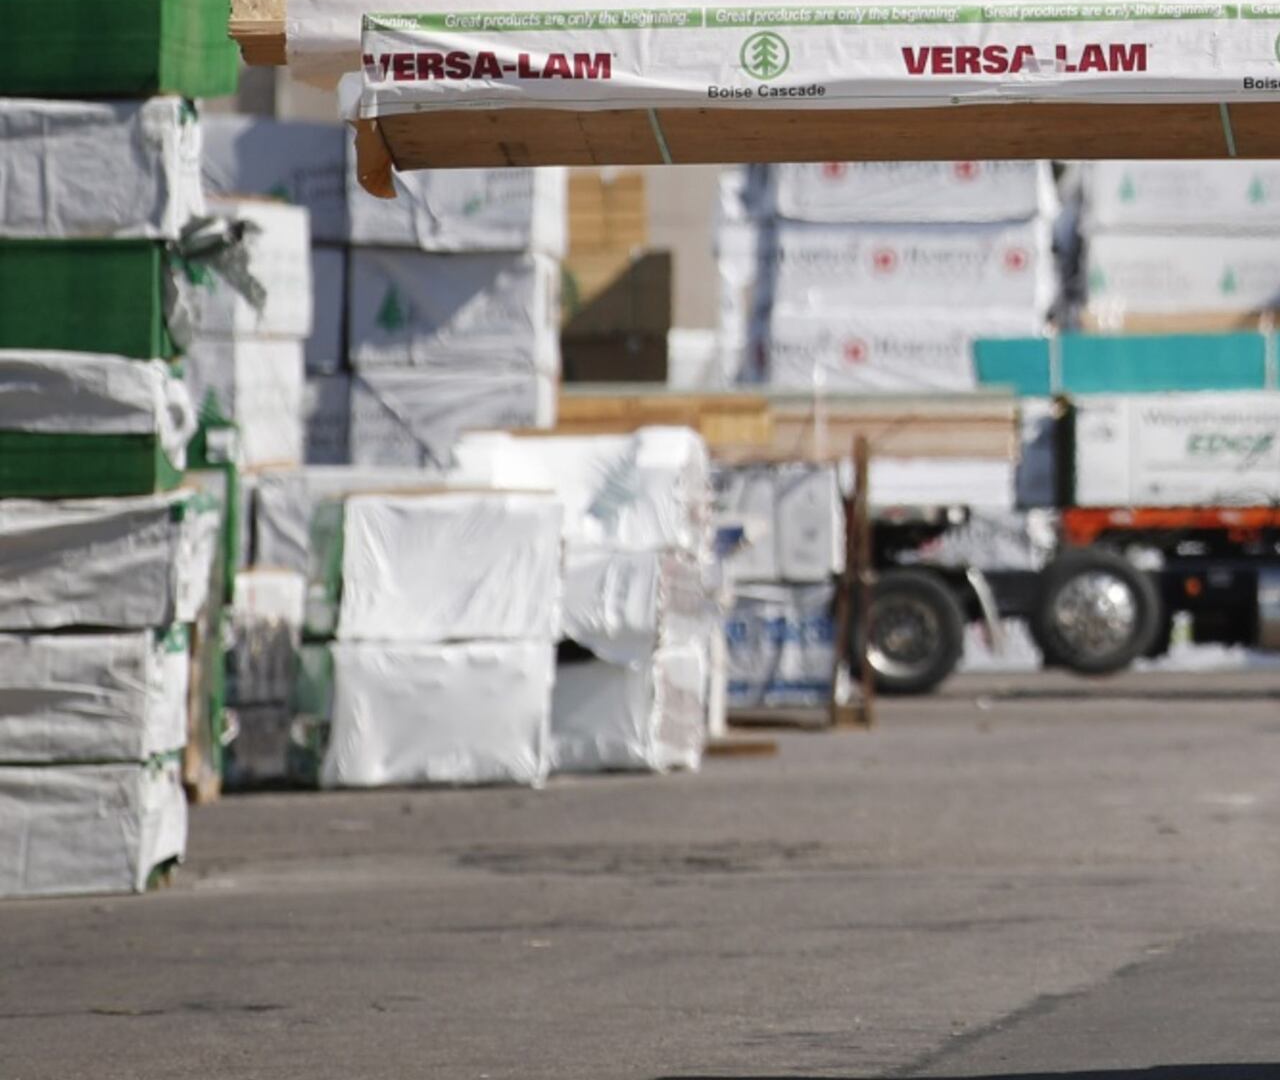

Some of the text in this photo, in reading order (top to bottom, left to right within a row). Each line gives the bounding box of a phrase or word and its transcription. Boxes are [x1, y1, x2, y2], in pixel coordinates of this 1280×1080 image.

[445, 13, 481, 27] Great
[484, 12, 539, 29] products
[545, 15, 564, 24] are
[568, 12, 596, 27] only
[599, 10, 619, 23] the
[716, 9, 752, 22] Great
[753, 8, 811, 24] products
[816, 10, 834, 20] are
[838, 8, 865, 22] only
[869, 7, 889, 19] the
[707, 83, 826, 98] Boise Cascade
